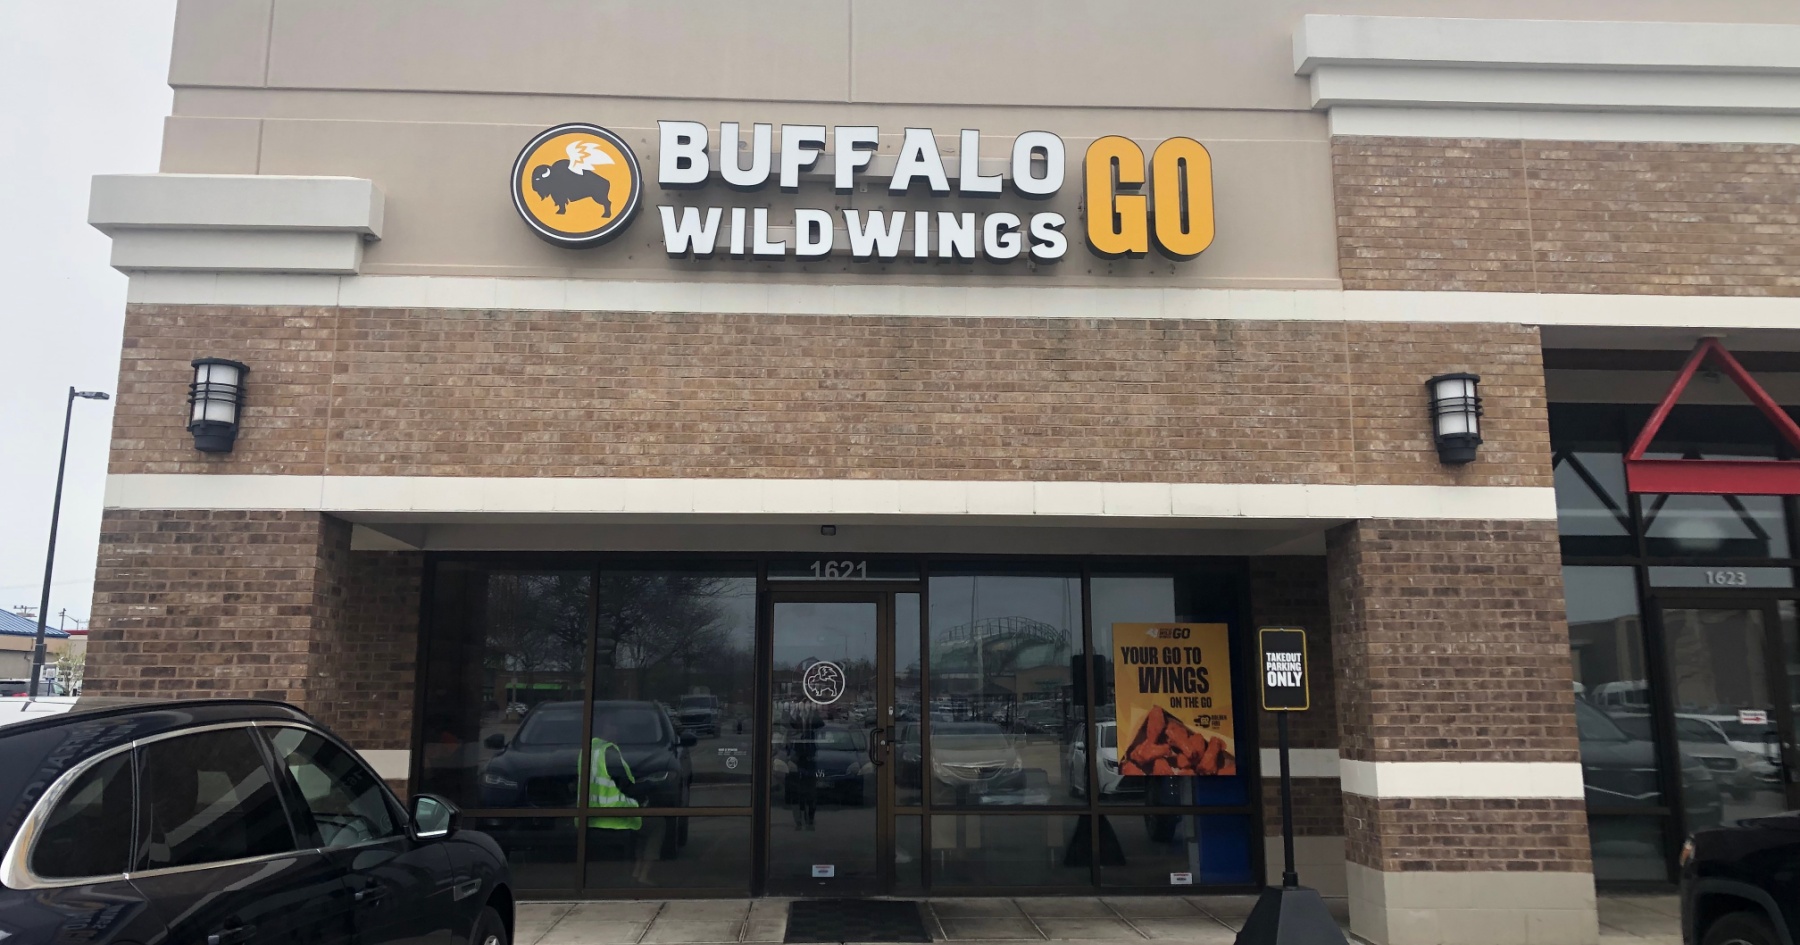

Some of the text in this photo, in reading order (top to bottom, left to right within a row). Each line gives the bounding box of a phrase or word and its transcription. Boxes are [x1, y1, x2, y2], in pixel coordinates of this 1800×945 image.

[657, 120, 1066, 196] BUFFALO
[1085, 136, 1214, 257] GO
[810, 560, 867, 580] 1621
[1706, 571, 1747, 585] 1623
[1174, 628, 1191, 639] GO
[1121, 647, 1202, 665] YOUR GO TO
[1266, 652, 1301, 662] TAKEOUT
[1266, 662, 1301, 671] PARKING
[1139, 667, 1210, 694] WINGS
[1267, 671, 1303, 687] ONLY
[1170, 697, 1212, 708] ON THE GO
